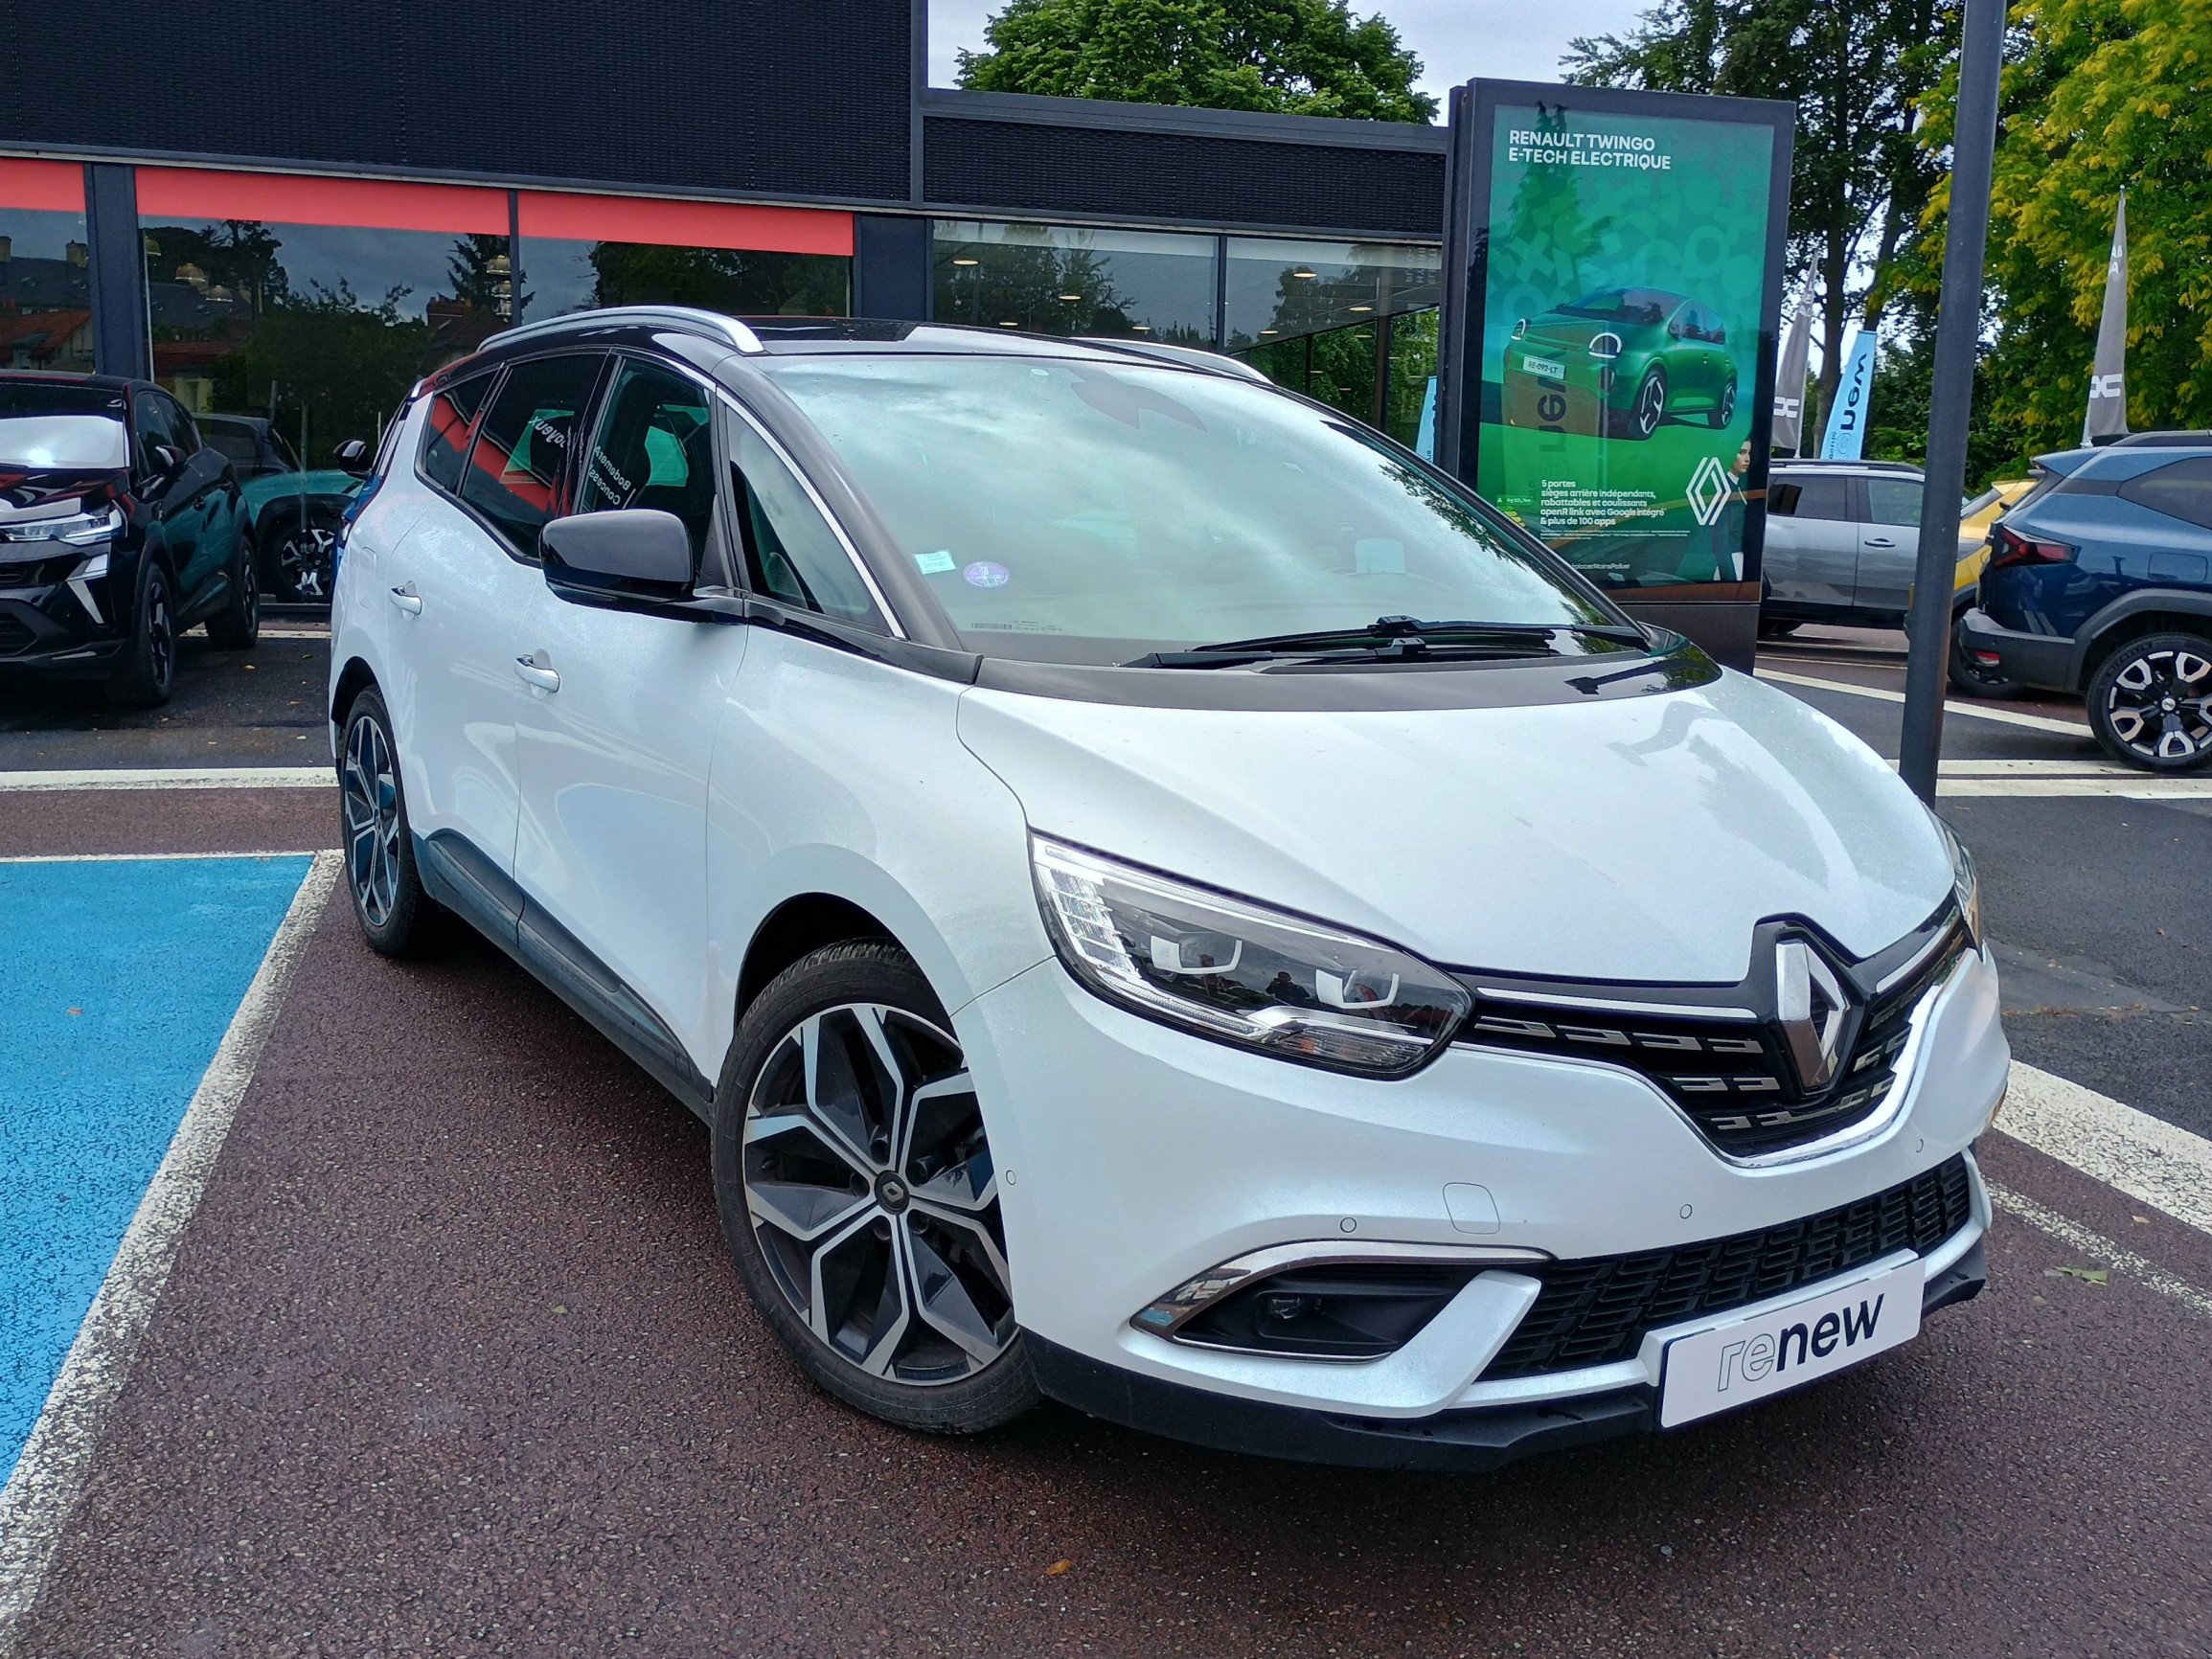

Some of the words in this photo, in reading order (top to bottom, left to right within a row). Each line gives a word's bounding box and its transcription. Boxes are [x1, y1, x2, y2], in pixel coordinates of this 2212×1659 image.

[1509, 129, 1585, 148] RENAULT
[1586, 134, 1655, 152] TWINGO
[1508, 148, 1568, 165] E-TECH
[1570, 151, 1672, 170] ELECTRIQUE
[1548, 481, 1576, 489] portes
[1540, 489, 1568, 498] sièges
[1569, 489, 1598, 497] arrière
[1599, 489, 1656, 499] indépendants,
[1602, 498, 1648, 507] coulissants
[1540, 508, 1568, 516] openR
[1568, 507, 1585, 515] link
[1607, 508, 1635, 517] Google
[1547, 517, 1565, 526] plus
[1594, 518, 1615, 527] apps
[1718, 1293, 1885, 1392] renew
